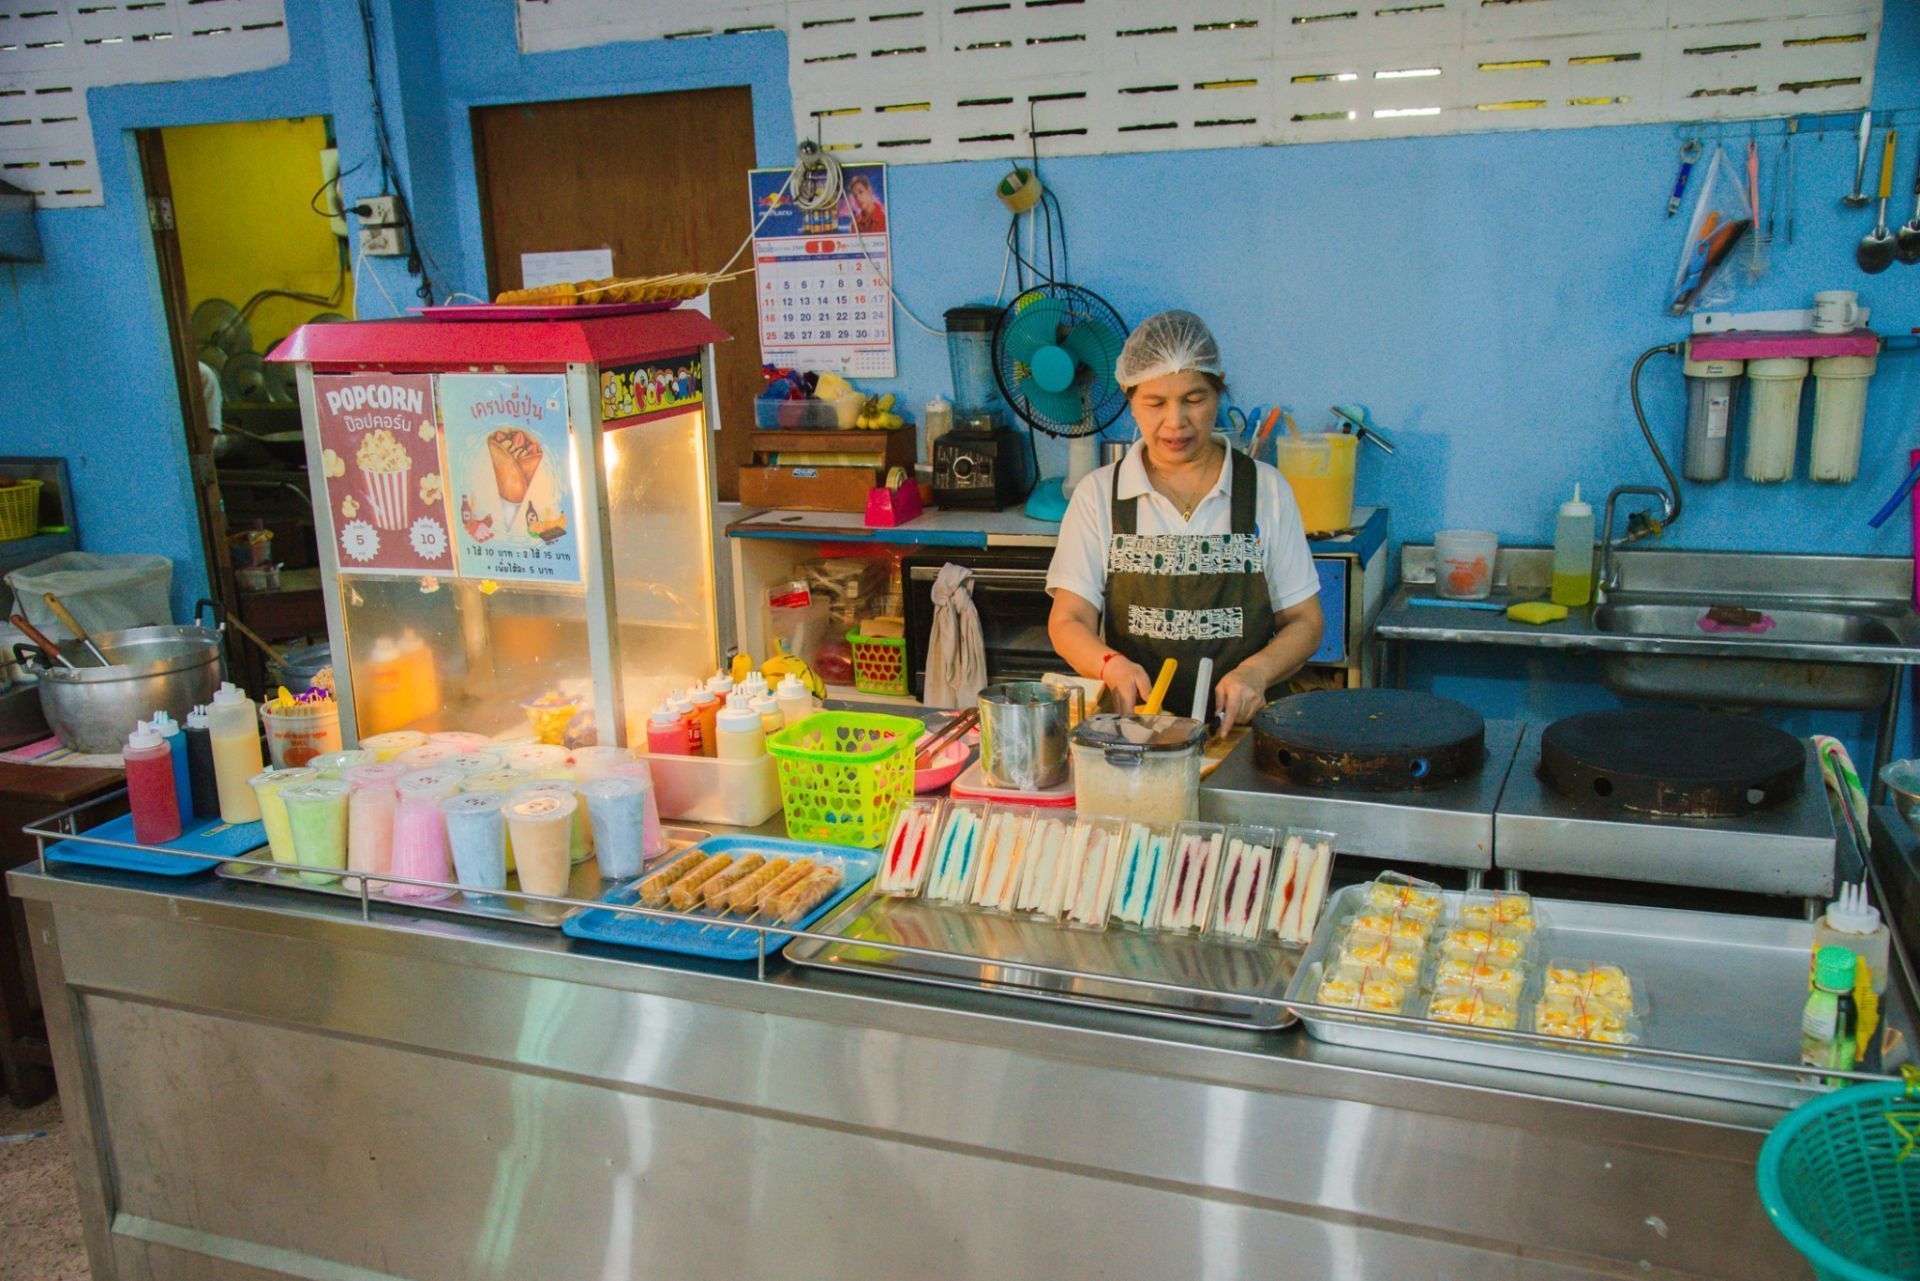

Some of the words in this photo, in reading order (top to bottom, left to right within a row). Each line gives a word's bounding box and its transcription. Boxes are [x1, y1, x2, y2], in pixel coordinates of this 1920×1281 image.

[856, 263, 862, 271] 2
[765, 282, 771, 290] 4
[784, 281, 790, 290] 5
[801, 280, 807, 289] 6
[819, 280, 825, 288] 7
[838, 279, 844, 288] 8
[856, 279, 863, 287] 9
[764, 298, 775, 306] 11
[783, 298, 793, 306] 12
[800, 297, 810, 305] 13
[817, 296, 828, 305] 14
[836, 295, 847, 304] 15
[854, 295, 866, 304] 16
[872, 295, 885, 303] 17
[783, 313, 794, 322] 19
[800, 313, 811, 322] 20
[819, 313, 830, 321] 21
[836, 312, 848, 321] 22
[854, 312, 866, 320] 23
[872, 311, 884, 320] 24
[766, 332, 777, 340] 25
[784, 331, 795, 340] 26
[801, 331, 813, 339] 27
[819, 330, 831, 339] 28
[838, 330, 849, 338] 29
[856, 329, 867, 338] 30
[874, 329, 885, 338] 31
[325, 384, 424, 416] POPCORN
[356, 534, 365, 546] 5
[421, 534, 436, 545] 10
[485, 548, 495, 556] 10
[523, 550, 528, 558] 2
[544, 551, 552, 559] 15
[556, 552, 571, 561] บาท
[529, 566, 535, 574] 5
[538, 567, 554, 575] บาท
